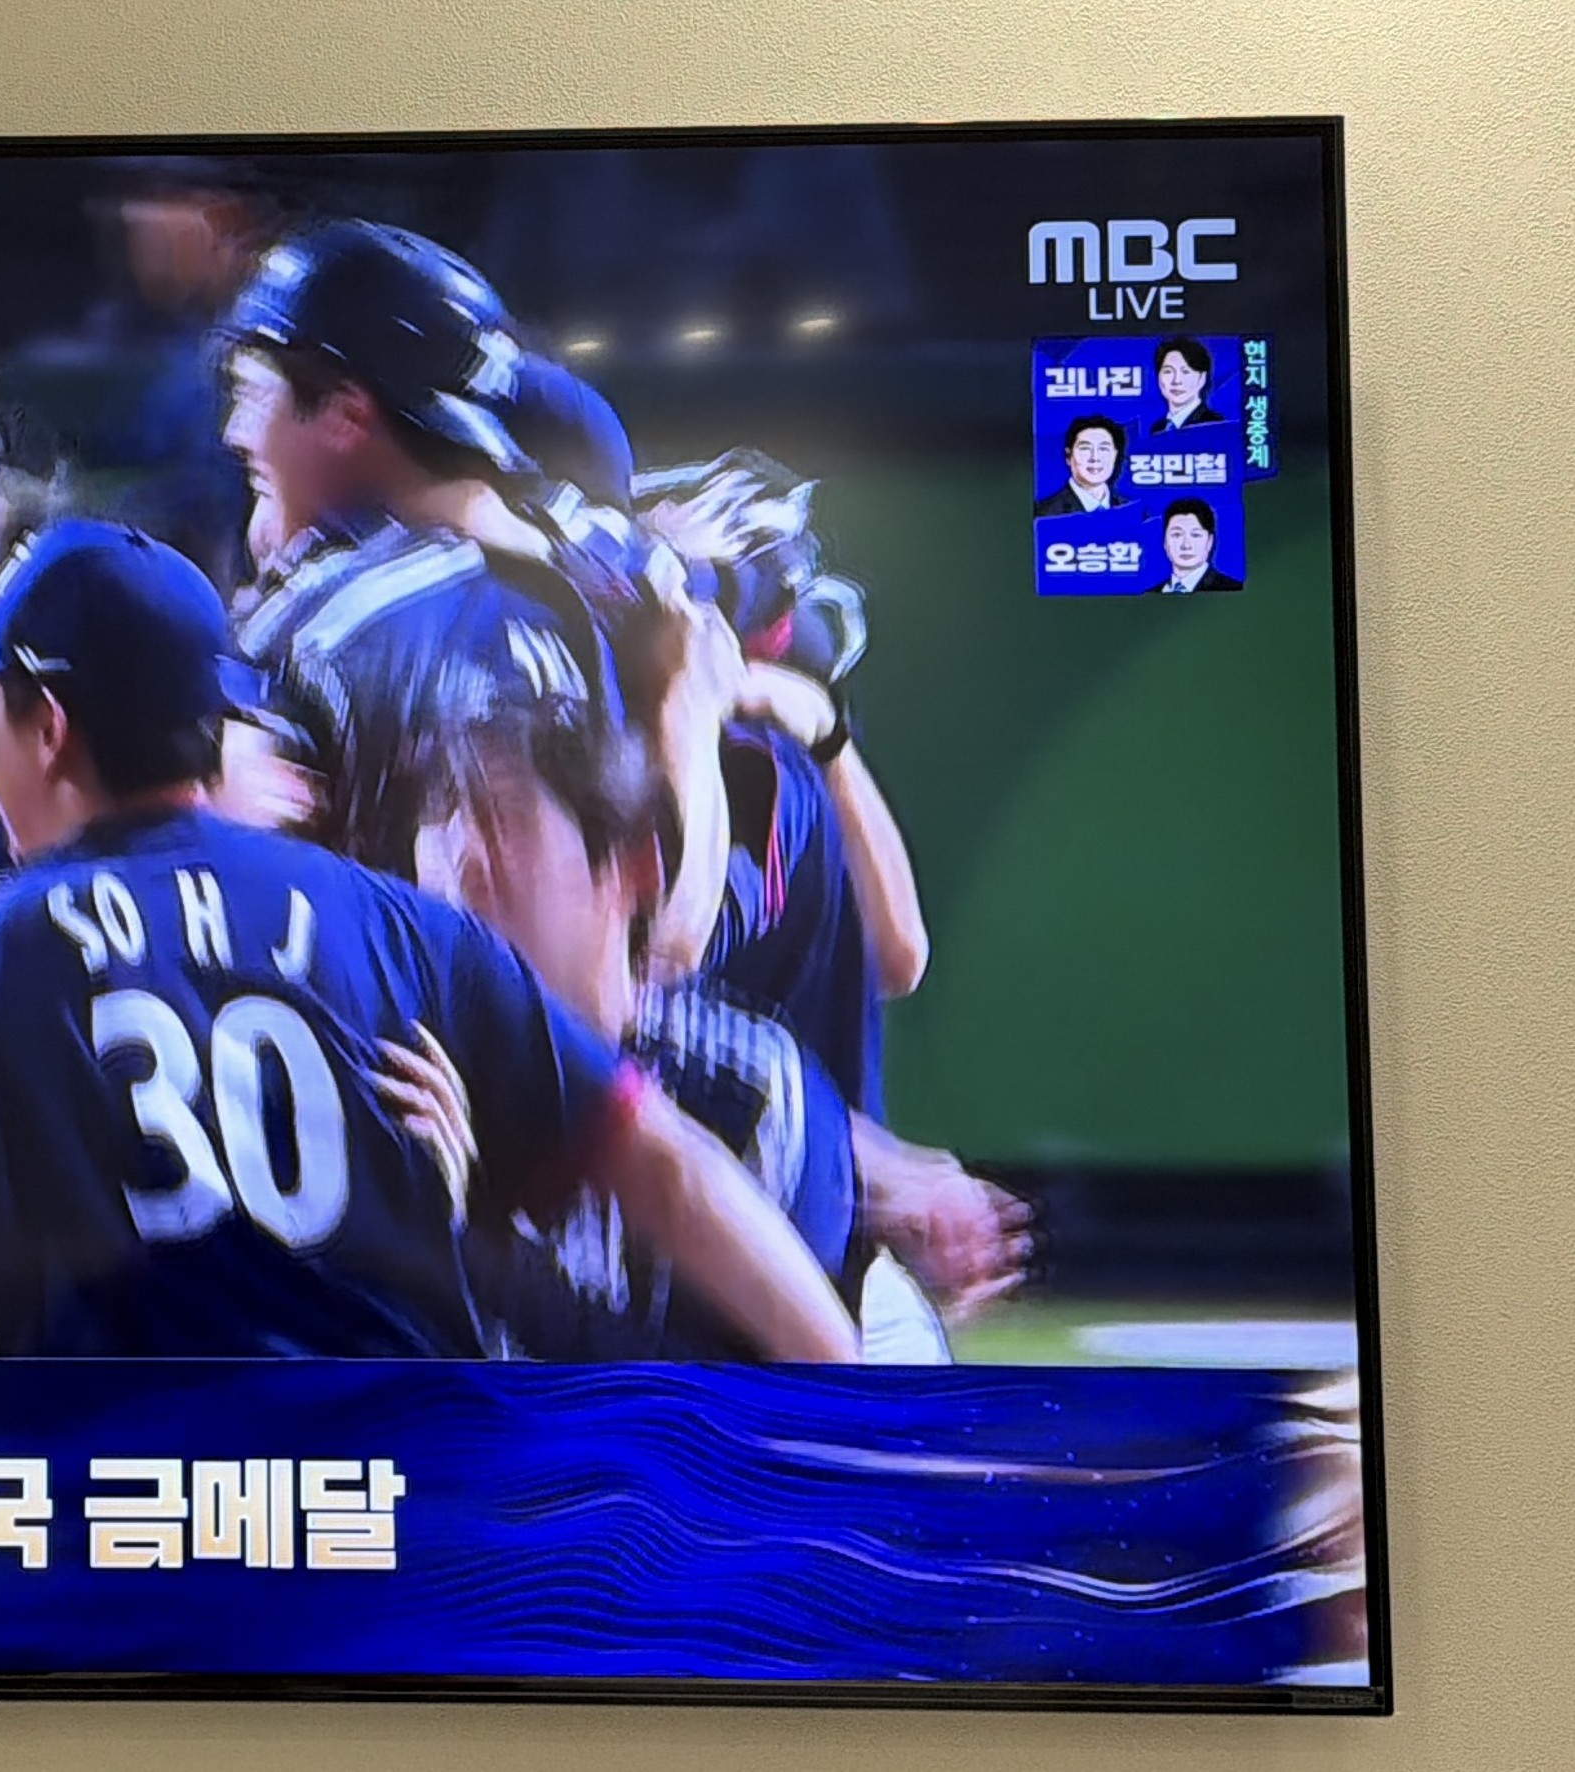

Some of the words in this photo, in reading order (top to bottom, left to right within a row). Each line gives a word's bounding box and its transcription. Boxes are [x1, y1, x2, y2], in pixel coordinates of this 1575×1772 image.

[1028, 218, 1238, 284] MBC
[1088, 286, 1185, 321] LIVE
[1044, 366, 1142, 397] 김나진
[1243, 340, 1267, 389] 현지
[1244, 395, 1270, 469] 생중계
[1129, 454, 1227, 484] 정민철
[1044, 542, 1142, 573] 오승환
[91, 988, 350, 1250] 30
[84, 1457, 407, 1570] 금메달
